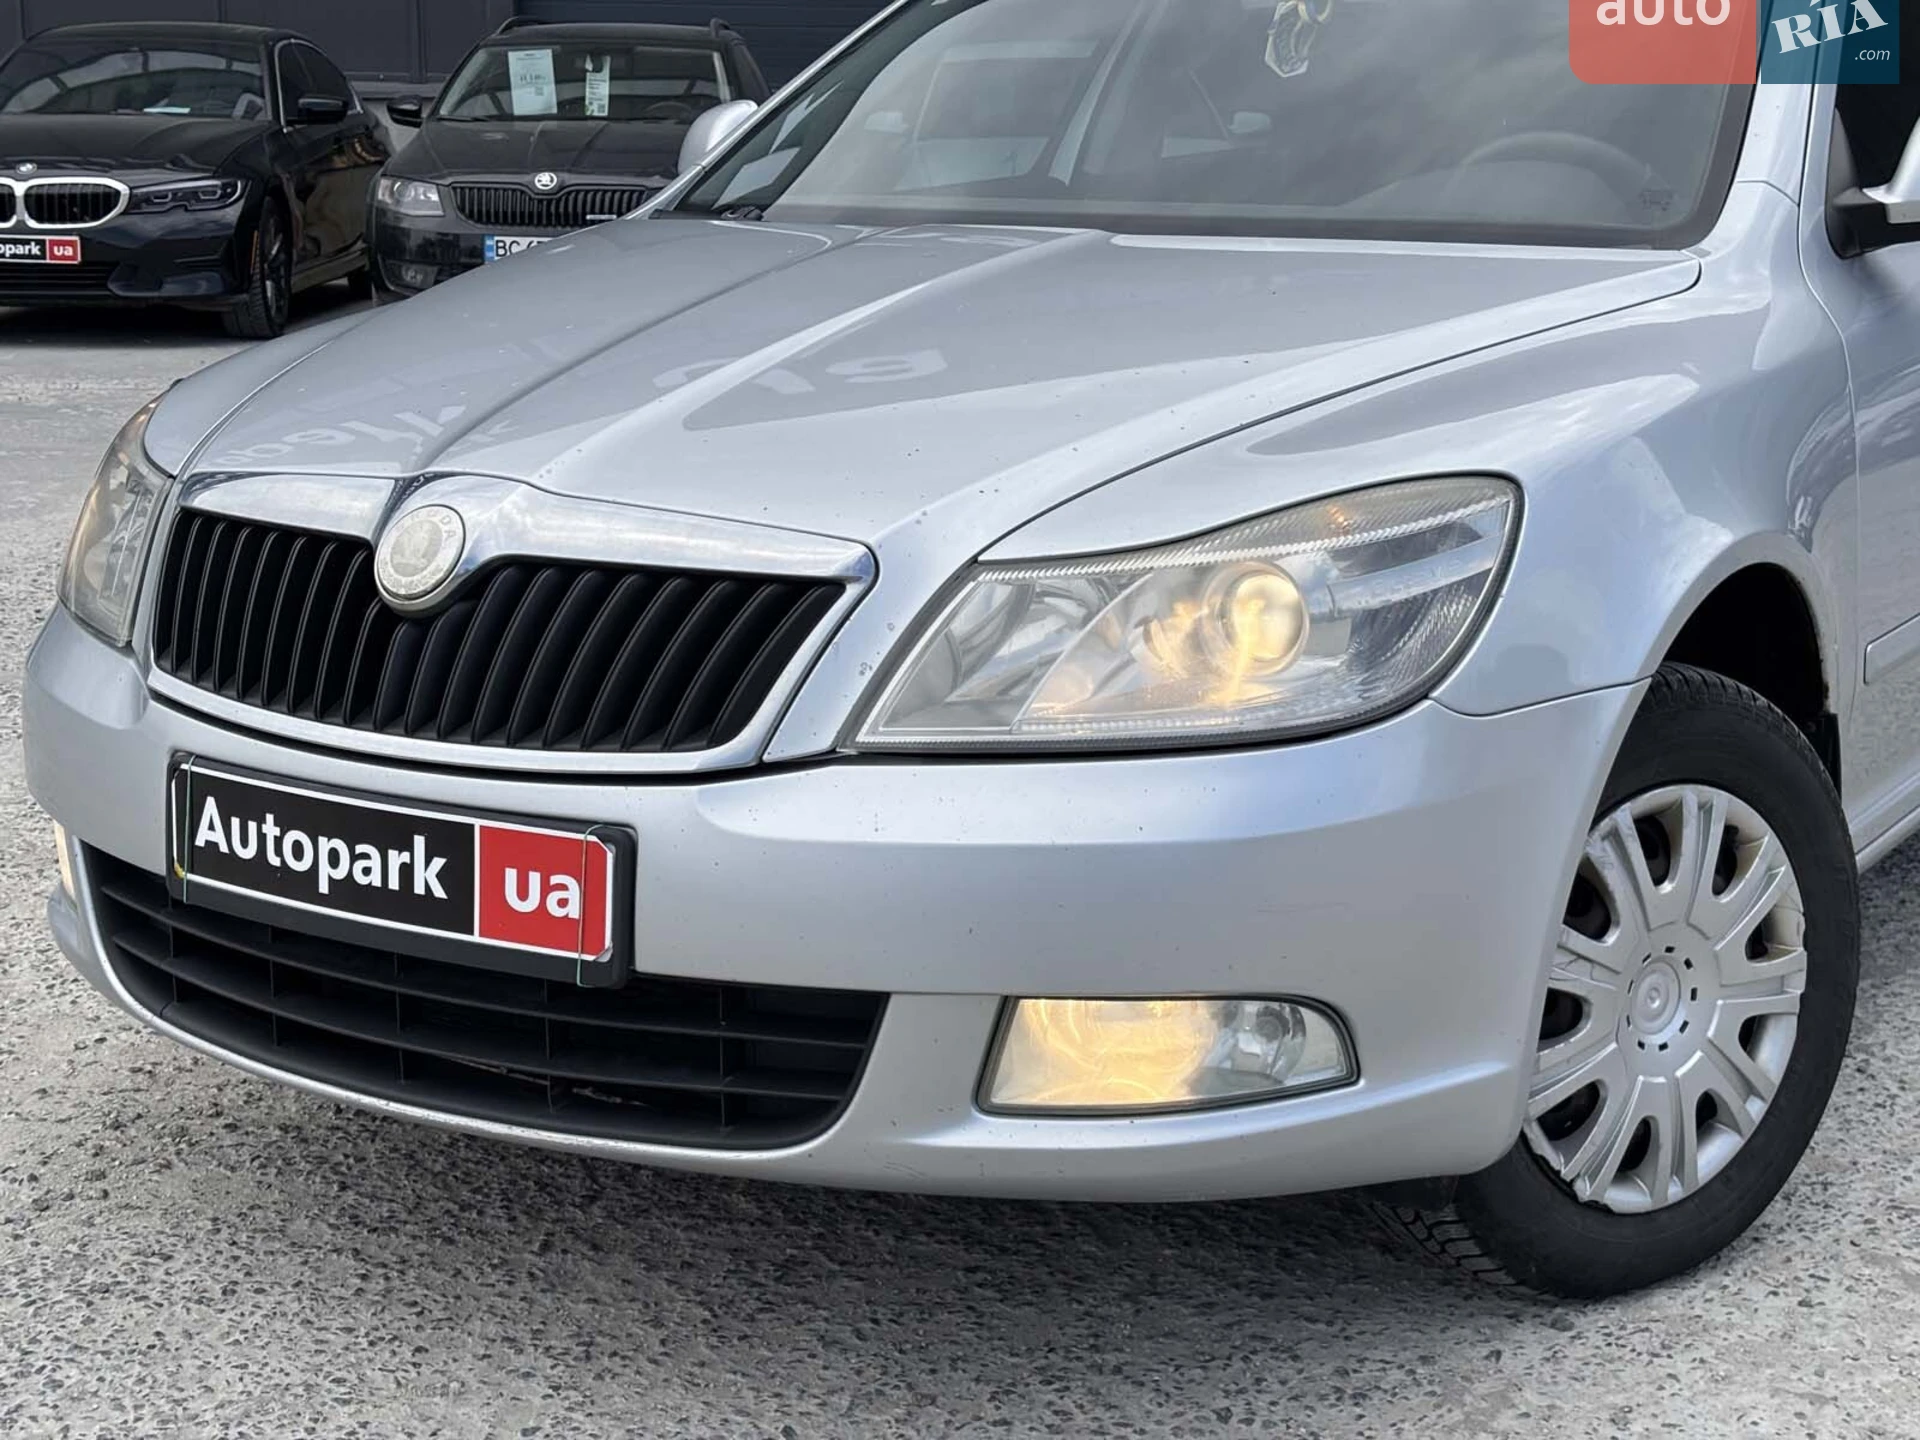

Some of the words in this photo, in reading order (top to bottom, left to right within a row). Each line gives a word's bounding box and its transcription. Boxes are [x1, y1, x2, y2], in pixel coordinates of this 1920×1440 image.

[53, 245, 74, 256] ua
[194, 796, 449, 900] Autopark
[503, 866, 580, 919] ua
